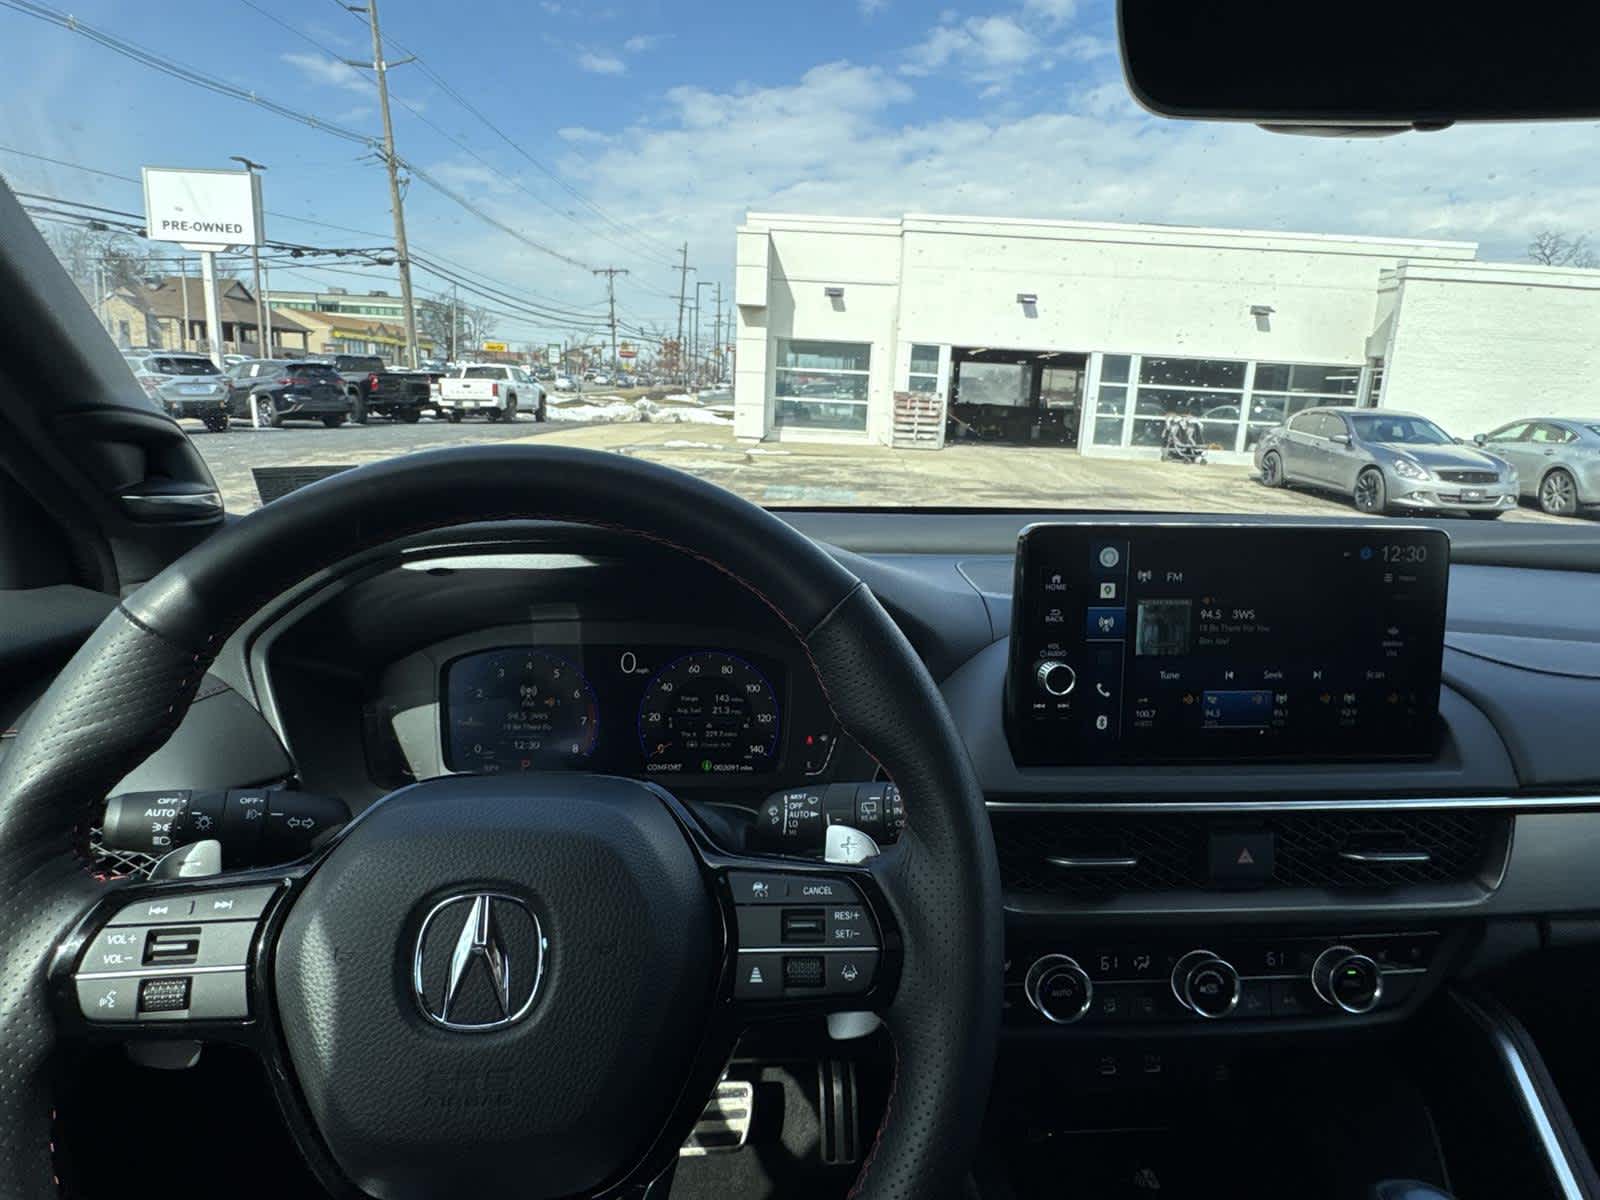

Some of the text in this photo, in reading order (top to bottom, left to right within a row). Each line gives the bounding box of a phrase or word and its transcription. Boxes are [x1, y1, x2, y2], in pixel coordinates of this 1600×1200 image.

[162, 220, 243, 234] PRE-OWNED
[1381, 545, 1427, 562] 12:30
[1166, 573, 1183, 582] FM
[1200, 609, 1256, 619] 94.5 3WS
[526, 662, 532, 670] 4
[620, 651, 637, 674] 0
[499, 669, 505, 677] 3
[554, 670, 560, 678] 5
[688, 665, 700, 674] 60
[721, 665, 733, 674] 80
[1160, 671, 1180, 679] Tune
[1263, 670, 1283, 680] Seek
[661, 683, 673, 692] 40
[746, 684, 760, 693] 100
[477, 689, 483, 697] 2
[574, 690, 581, 698] 6
[580, 716, 587, 725] 7
[649, 713, 661, 722] 20
[757, 713, 772, 722] 120
[475, 744, 482, 753] 0
[572, 744, 579, 753] 8
[750, 745, 764, 754] 140
[647, 763, 682, 771] COMFORT
[240, 797, 259, 805] OFF
[789, 802, 803, 810] OFF
[145, 809, 175, 817] AUTO
[789, 810, 809, 818] AUTO
[788, 820, 798, 828] LO
[803, 886, 833, 895] CANCEL
